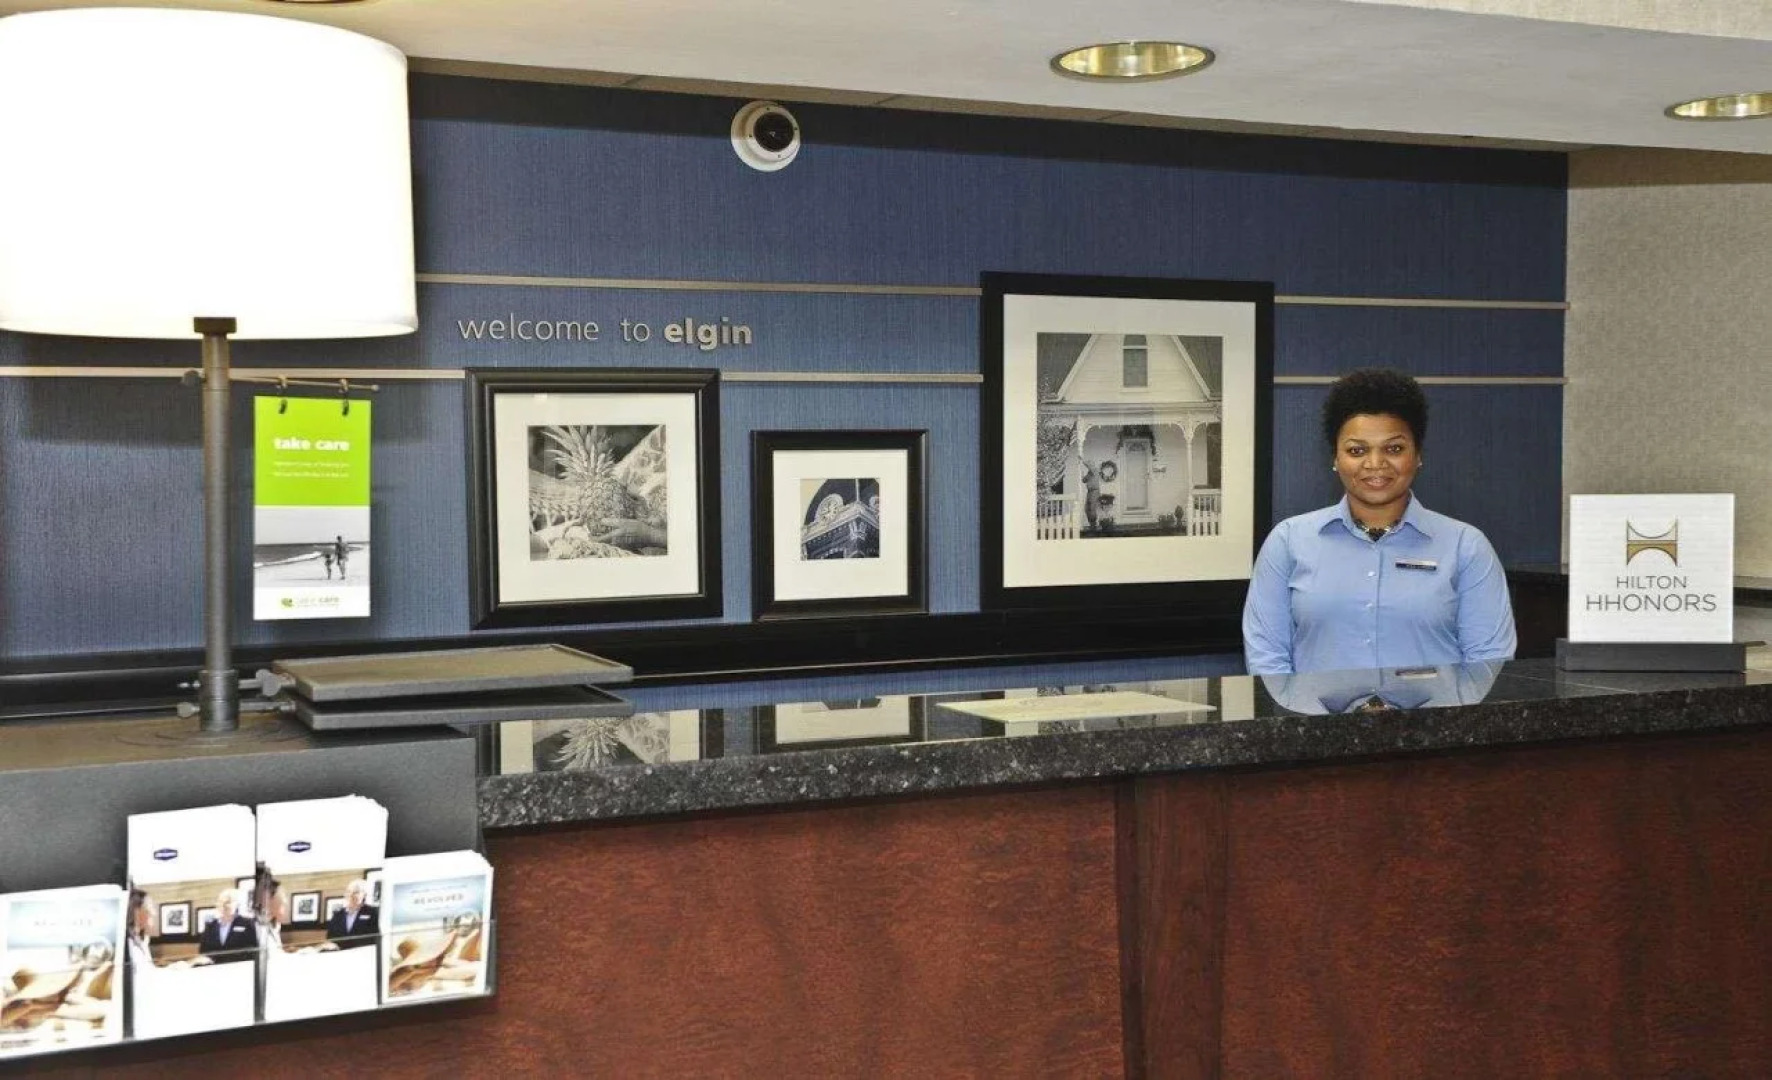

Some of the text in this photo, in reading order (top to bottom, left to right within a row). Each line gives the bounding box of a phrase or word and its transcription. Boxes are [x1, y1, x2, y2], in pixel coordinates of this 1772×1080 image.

[458, 313, 752, 350] welcome to elgin
[274, 437, 350, 451] take care
[1616, 576, 1688, 589] HILTON
[1586, 594, 1717, 612] HHONORS
